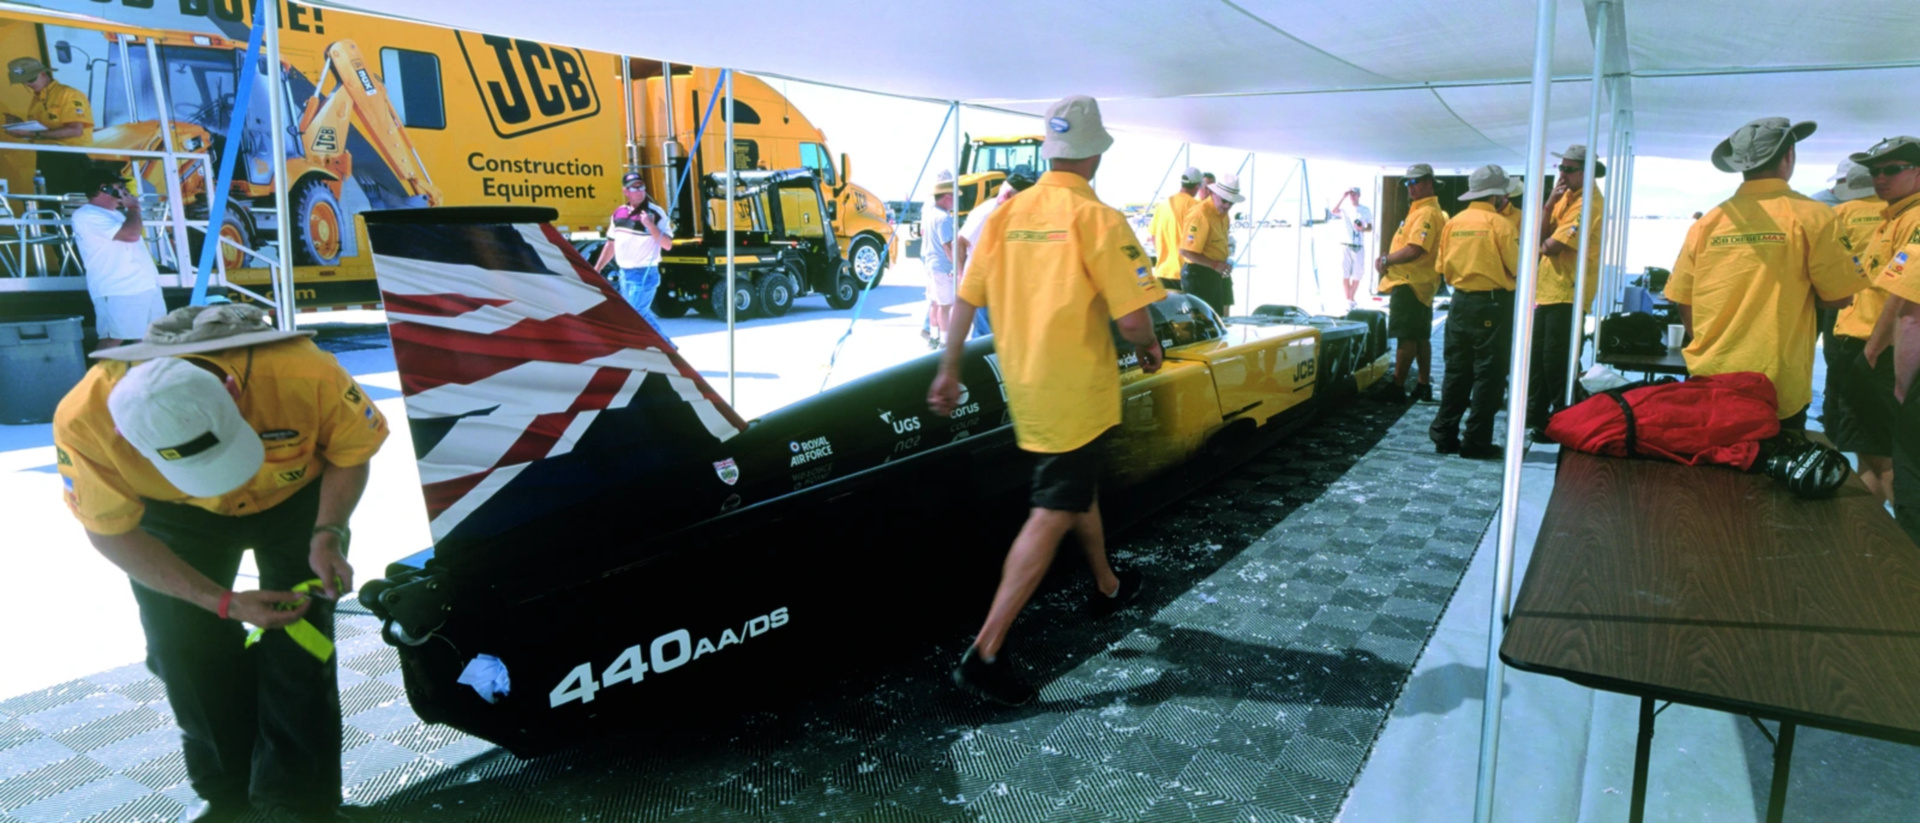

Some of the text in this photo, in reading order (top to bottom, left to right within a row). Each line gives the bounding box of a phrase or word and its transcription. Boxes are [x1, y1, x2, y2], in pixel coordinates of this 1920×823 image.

[482, 33, 591, 124] JCB
[316, 128, 336, 150] JCB
[467, 152, 604, 177] Construction
[483, 177, 596, 203] Equipment
[1293, 358, 1315, 383] JCB
[949, 402, 980, 419] corus
[892, 416, 921, 435] UGS
[801, 435, 830, 452] ROYAL
[790, 444, 834, 468] AIR FORCE
